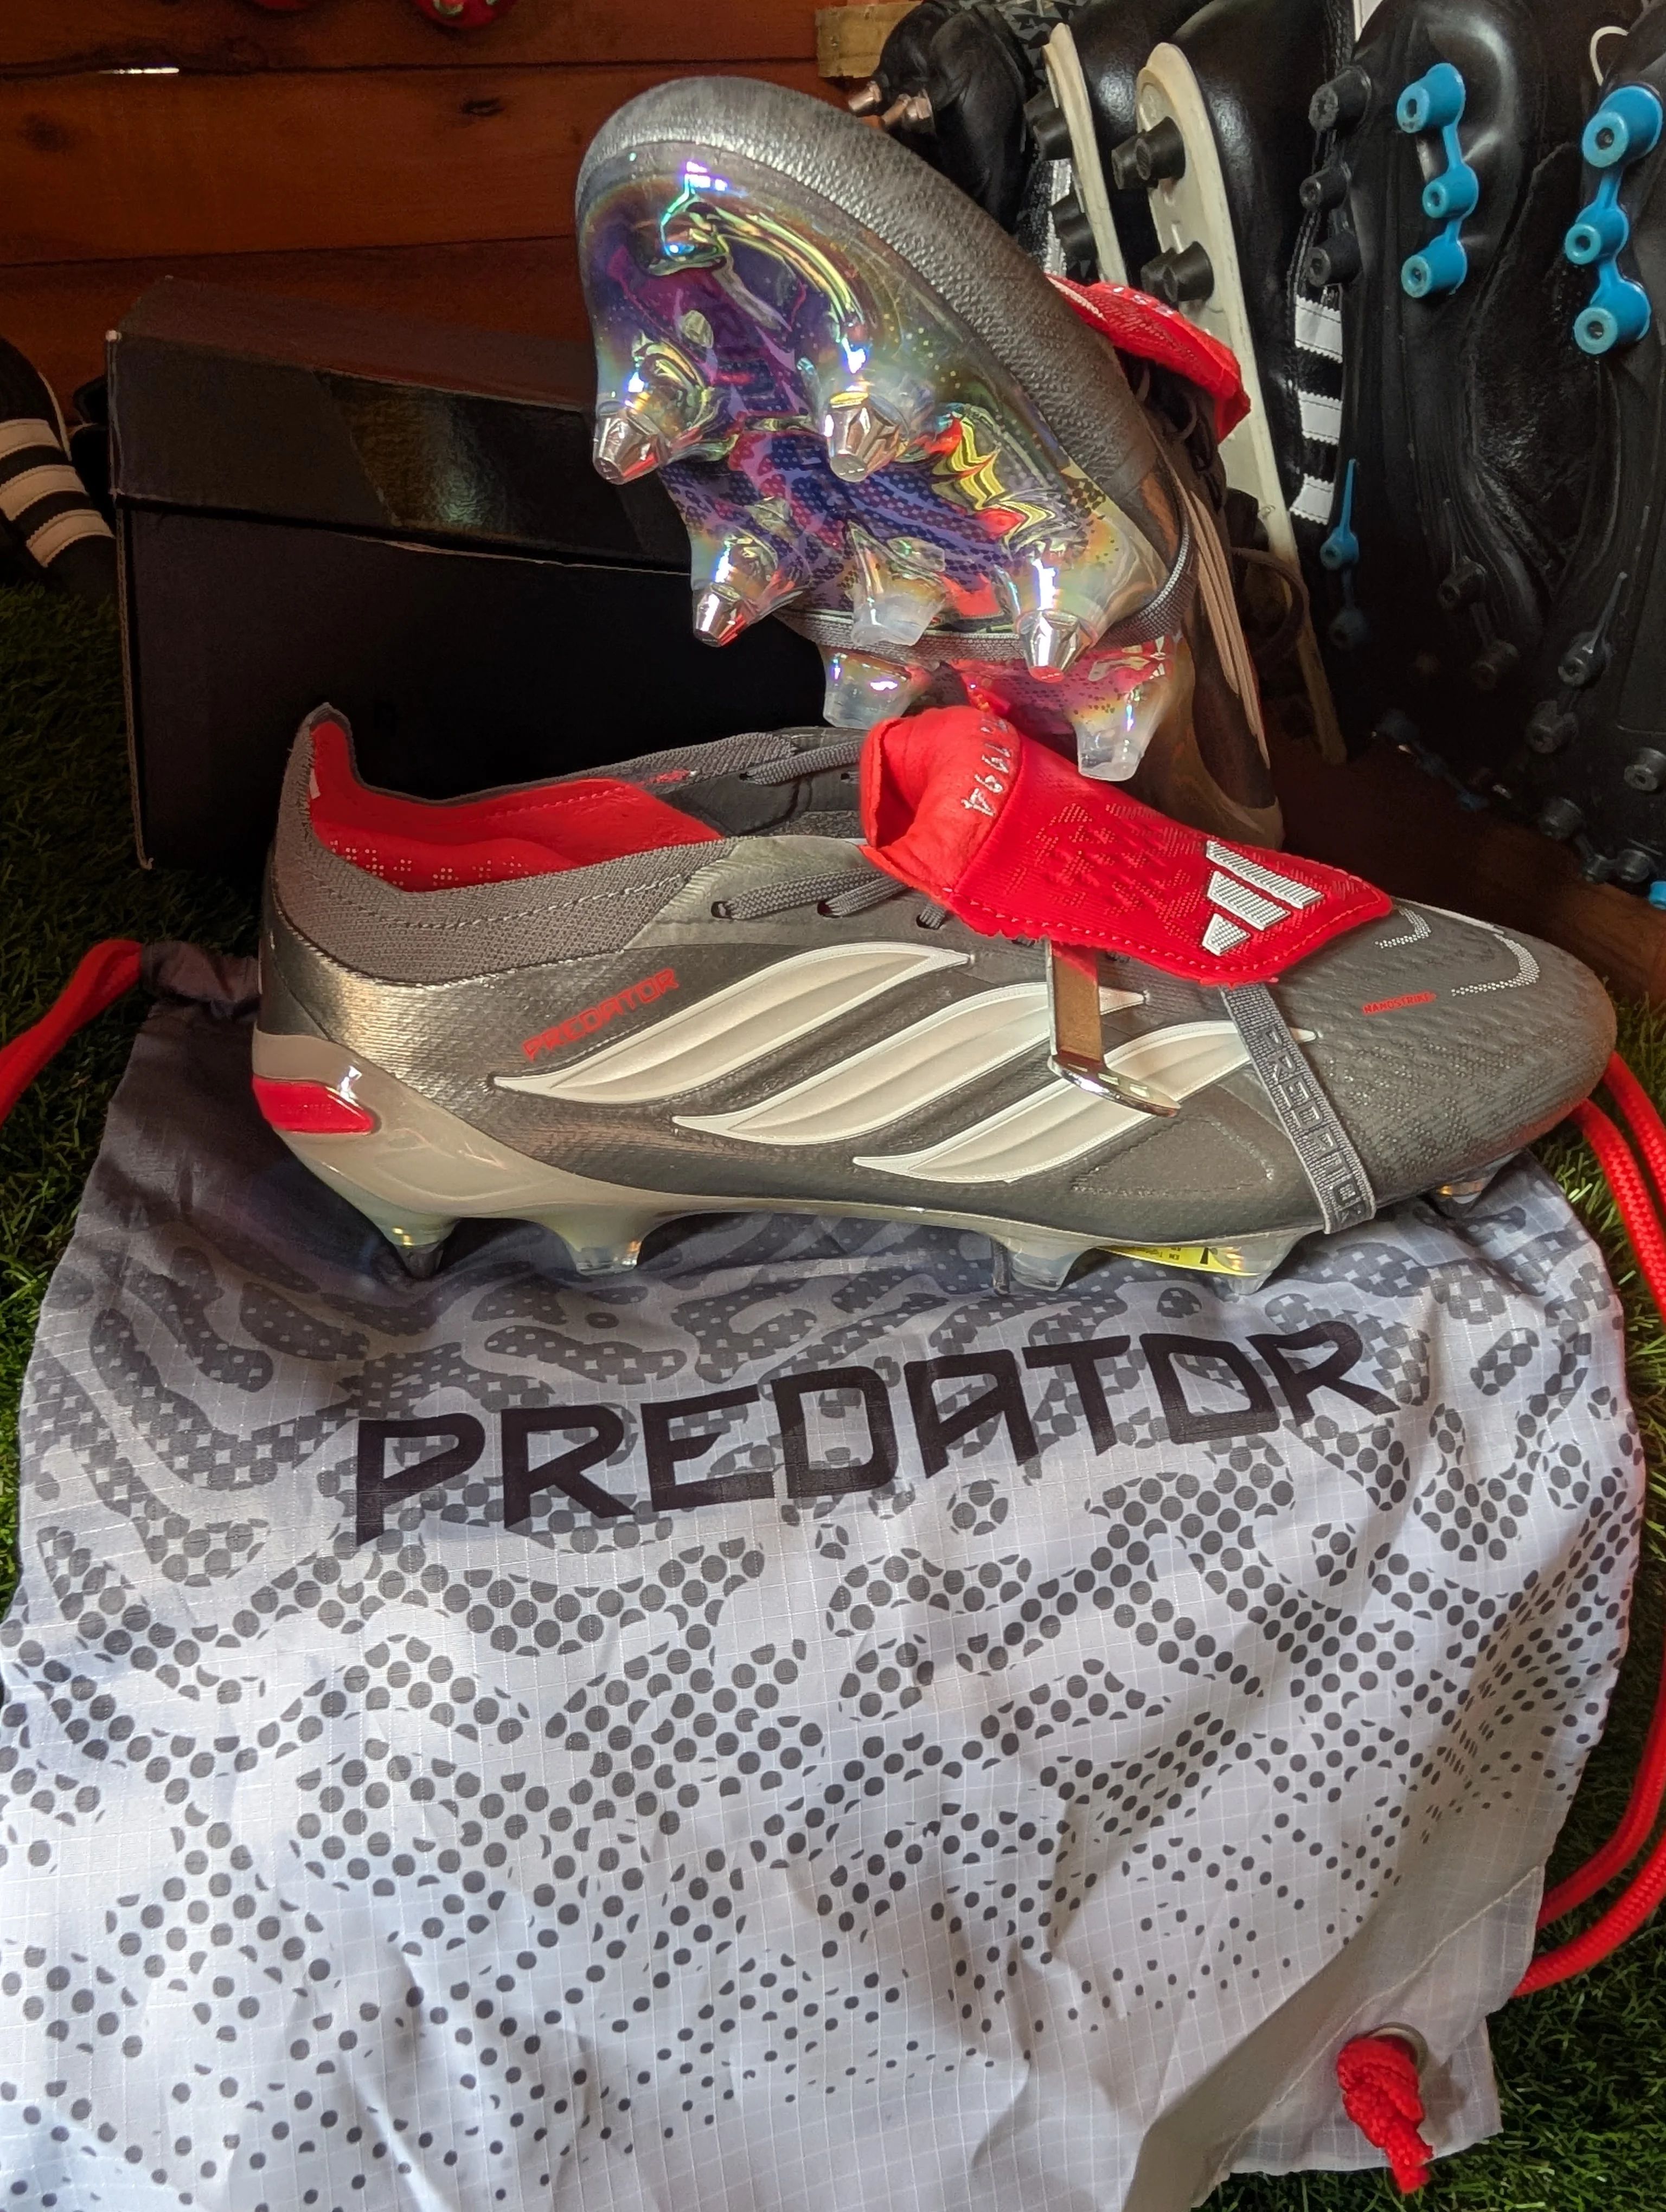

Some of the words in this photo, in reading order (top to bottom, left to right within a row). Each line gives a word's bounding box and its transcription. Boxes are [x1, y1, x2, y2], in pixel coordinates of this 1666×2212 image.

[522, 968, 679, 1062] PREDATOR
[1261, 1025, 1371, 1222] PREDATOR
[355, 1321, 1401, 1545] PREDATOR
